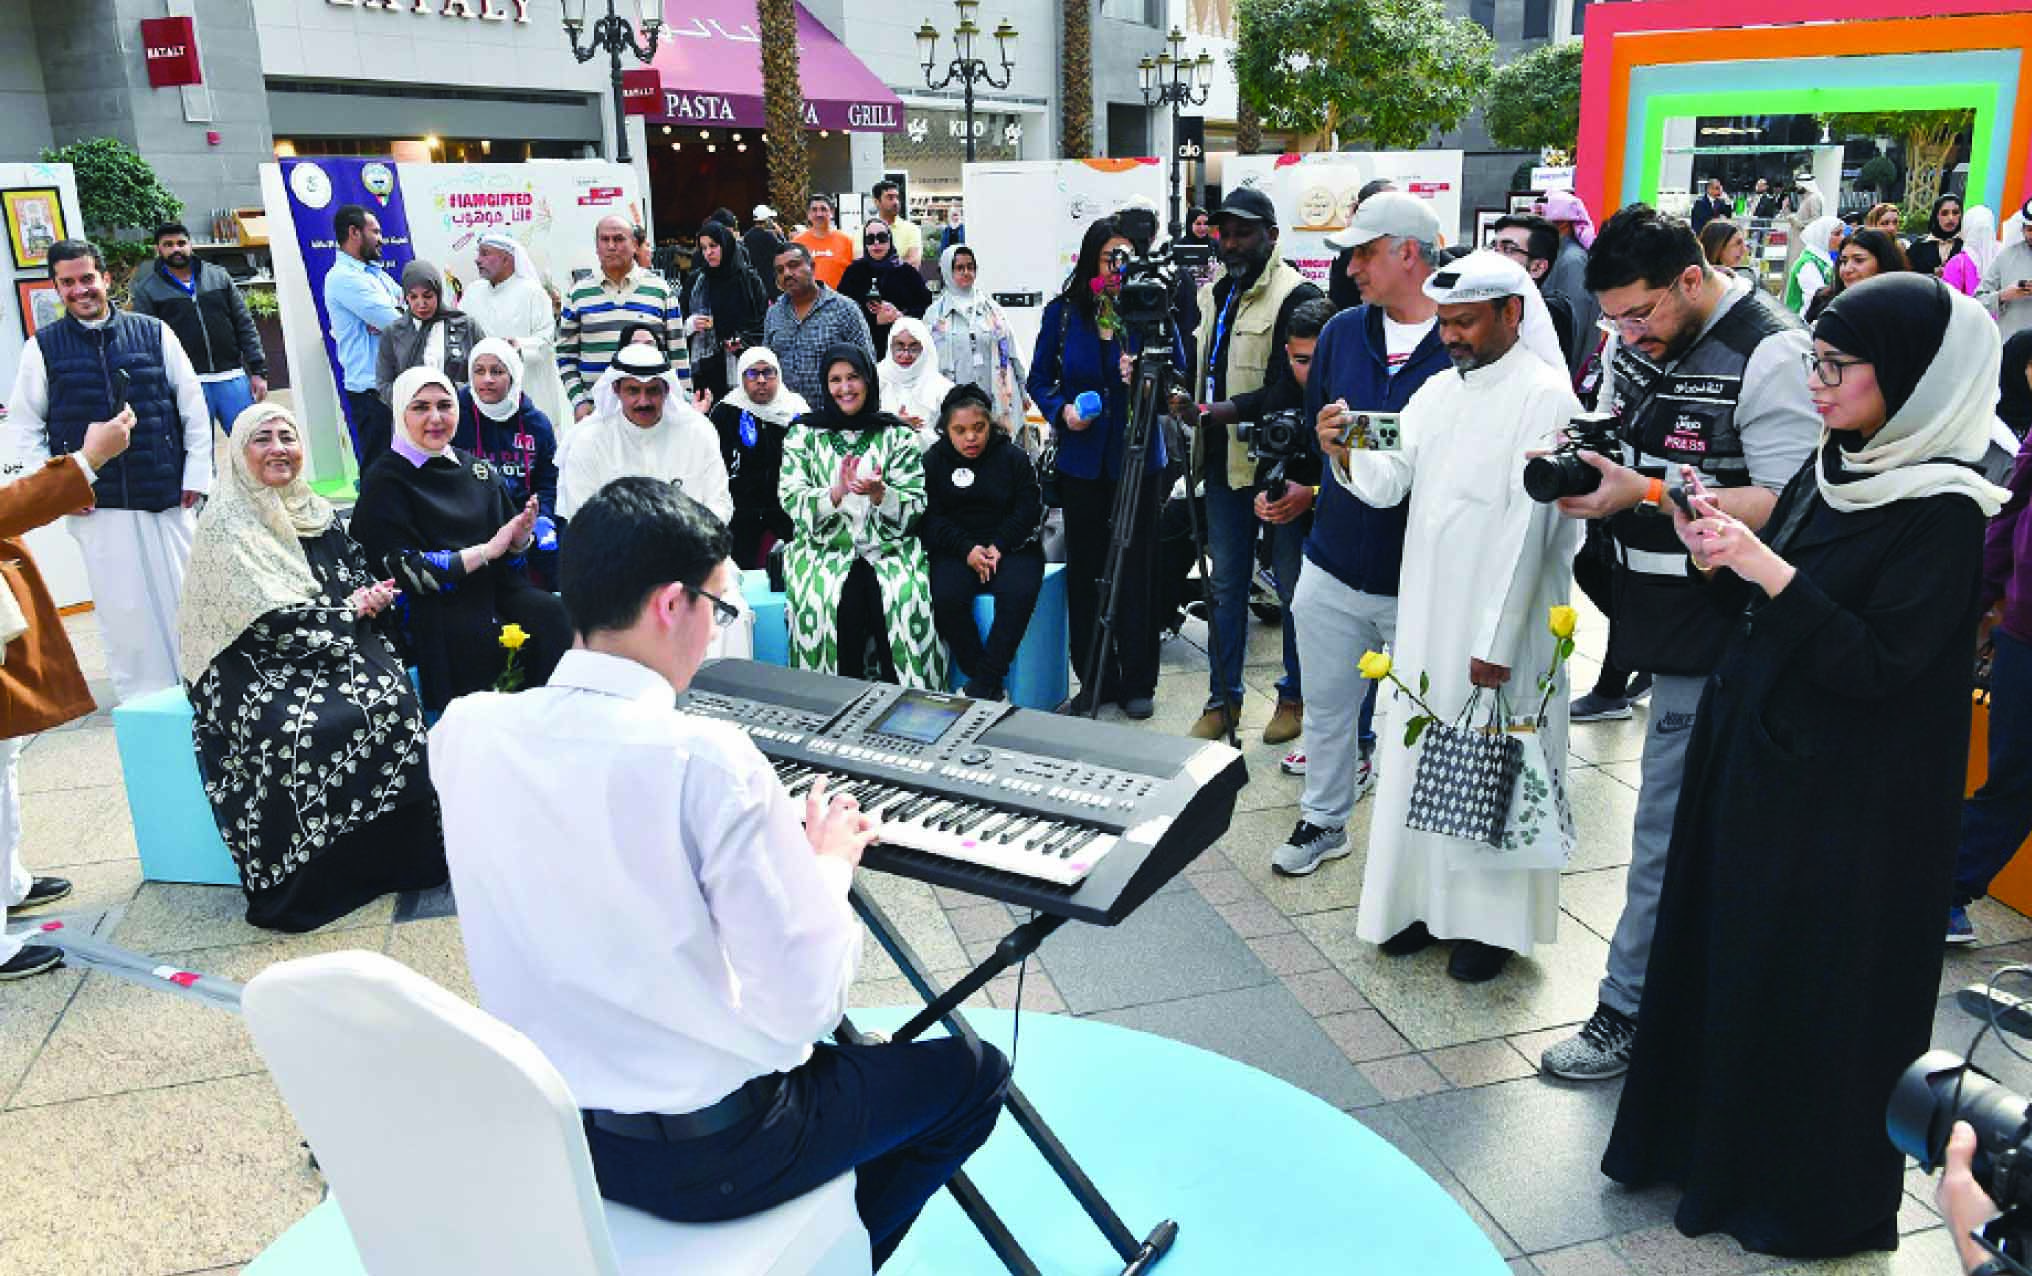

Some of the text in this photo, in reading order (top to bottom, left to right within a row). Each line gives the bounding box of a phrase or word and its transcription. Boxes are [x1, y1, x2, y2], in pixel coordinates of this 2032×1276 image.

[325, 0, 531, 24] ALY
[666, 94, 736, 121] PASTA
[848, 104, 897, 127] GRILL
[949, 120, 984, 137] KIO
[449, 193, 533, 208] #IAMGIFTED
[1664, 434, 1706, 452] PRESS
